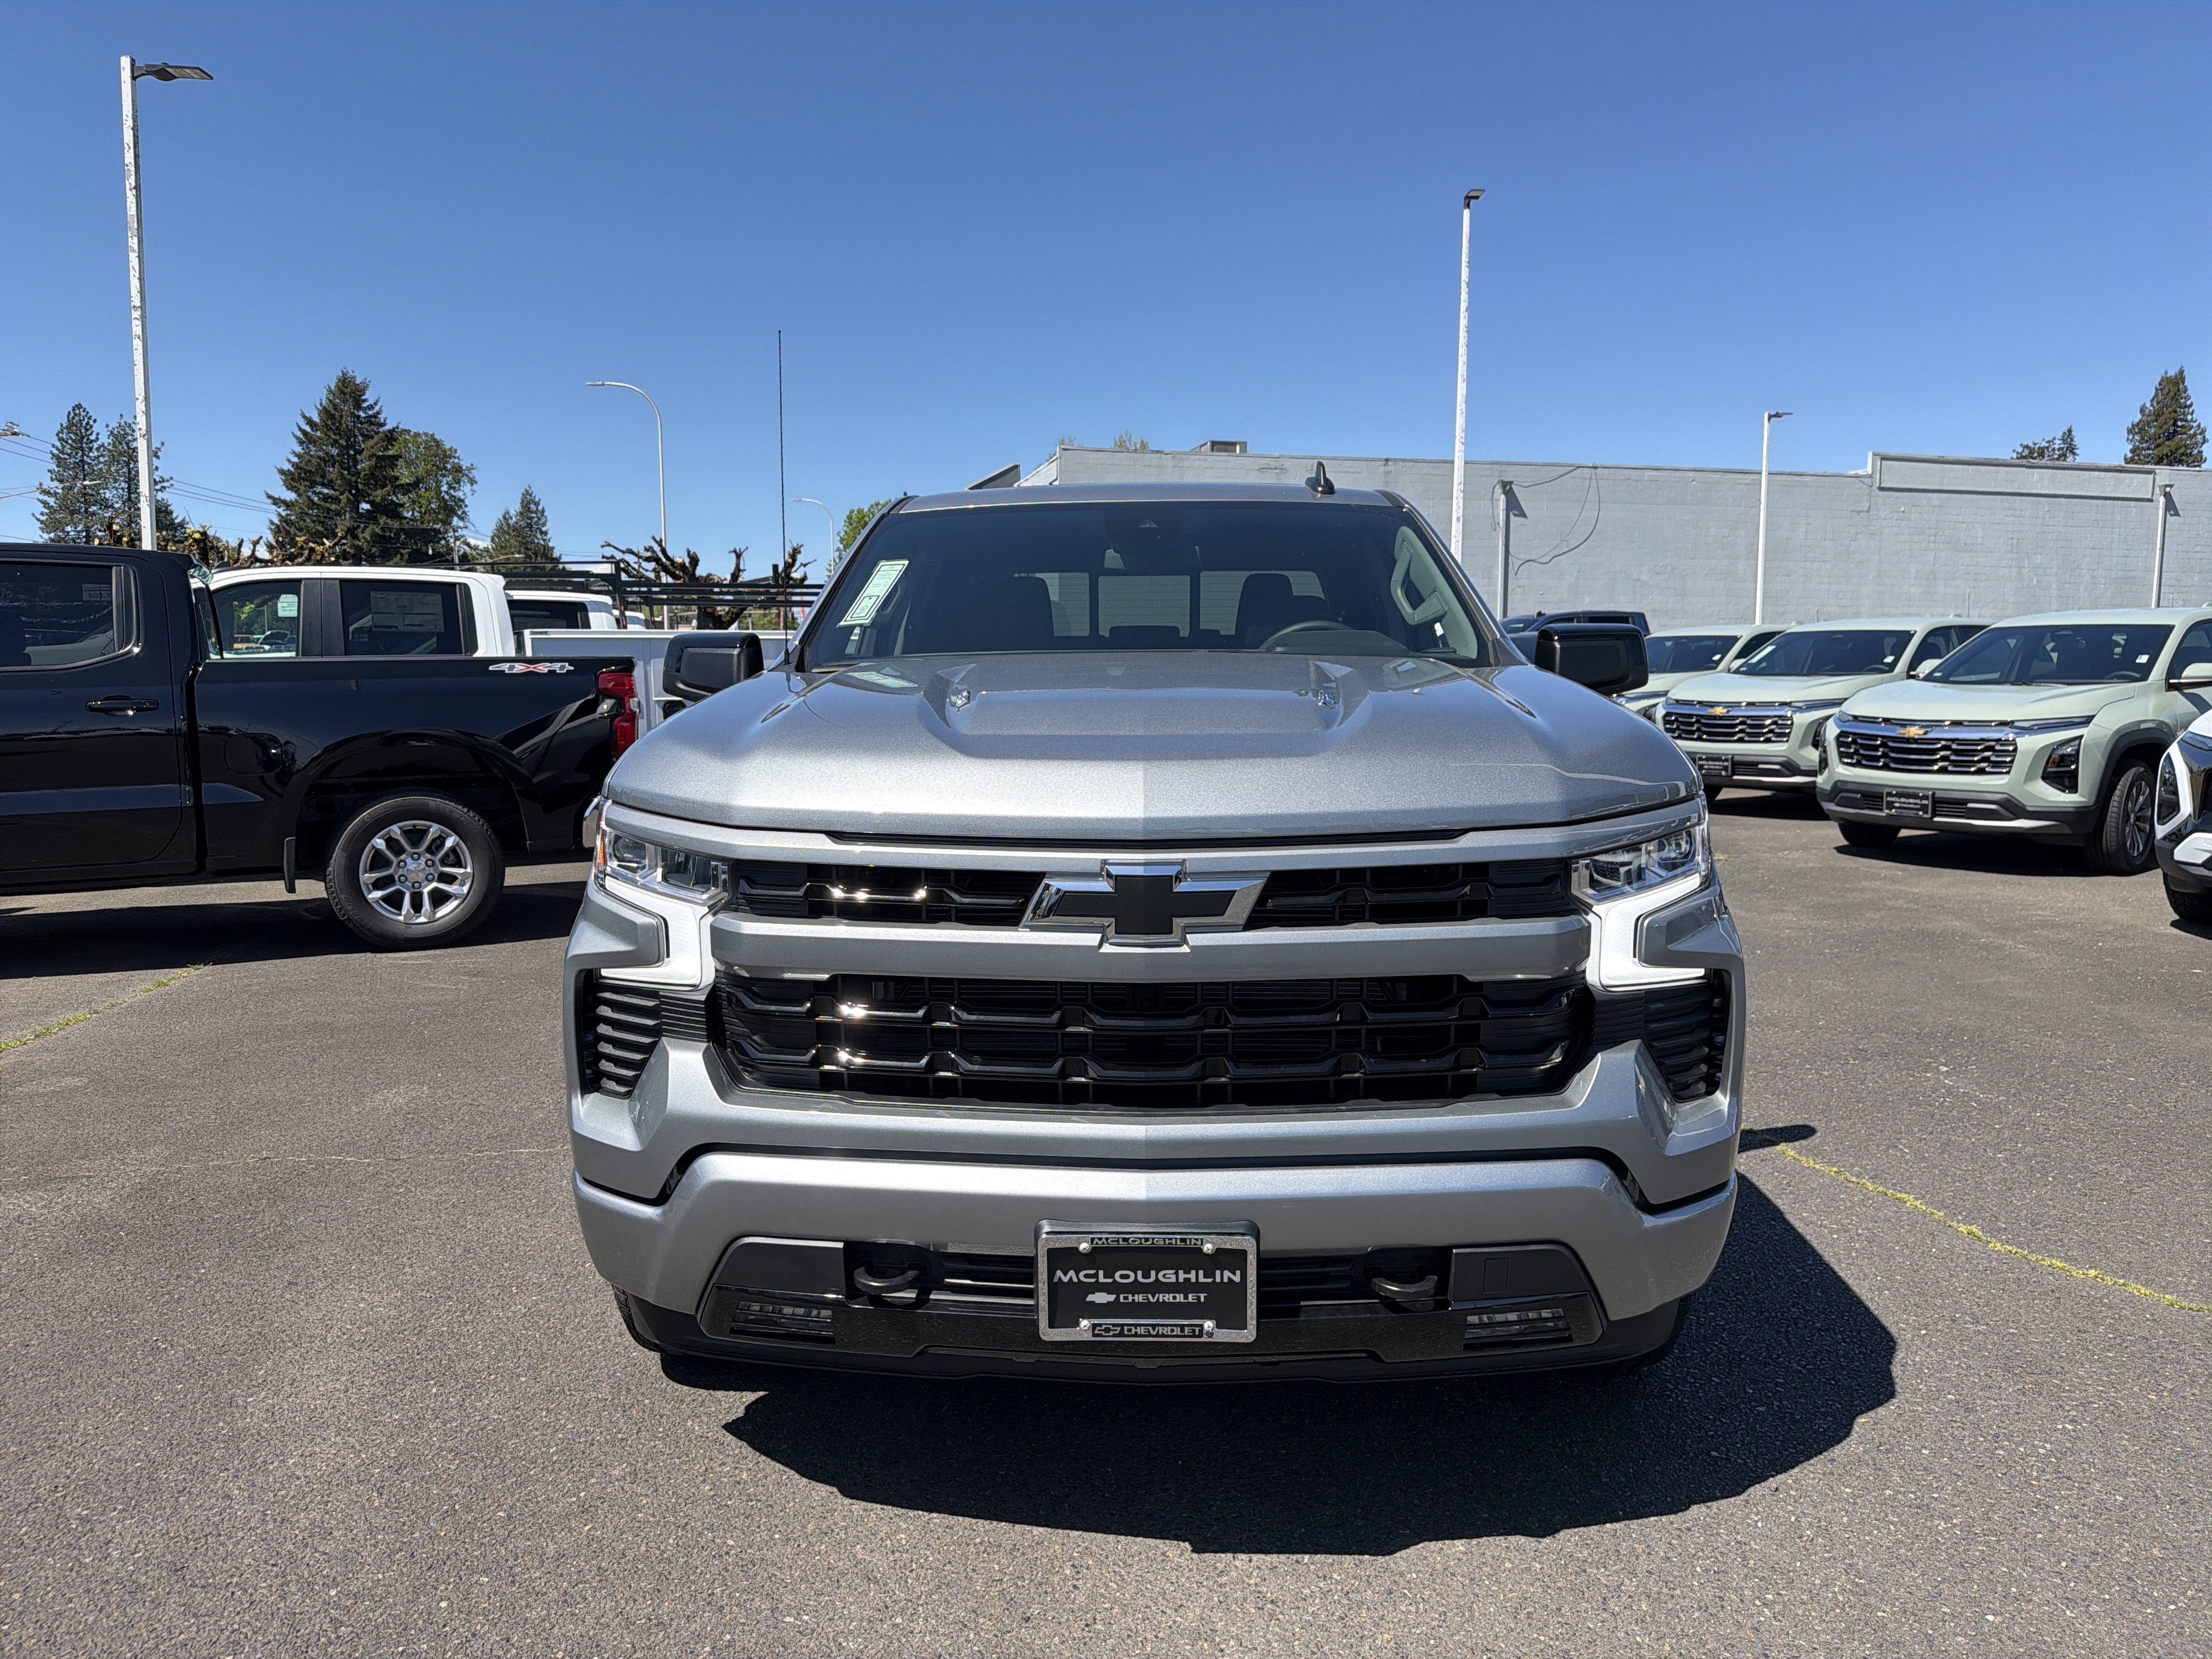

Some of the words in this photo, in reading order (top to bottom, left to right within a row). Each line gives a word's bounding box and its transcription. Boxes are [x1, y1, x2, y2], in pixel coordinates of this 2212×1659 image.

[1093, 1237, 1202, 1246] MCLOUGHLIN
[1053, 1269, 1241, 1284] MCLOUGHLIN
[1119, 1293, 1208, 1303] CHEVROLET
[1124, 1326, 1201, 1336] CHEVROLET
